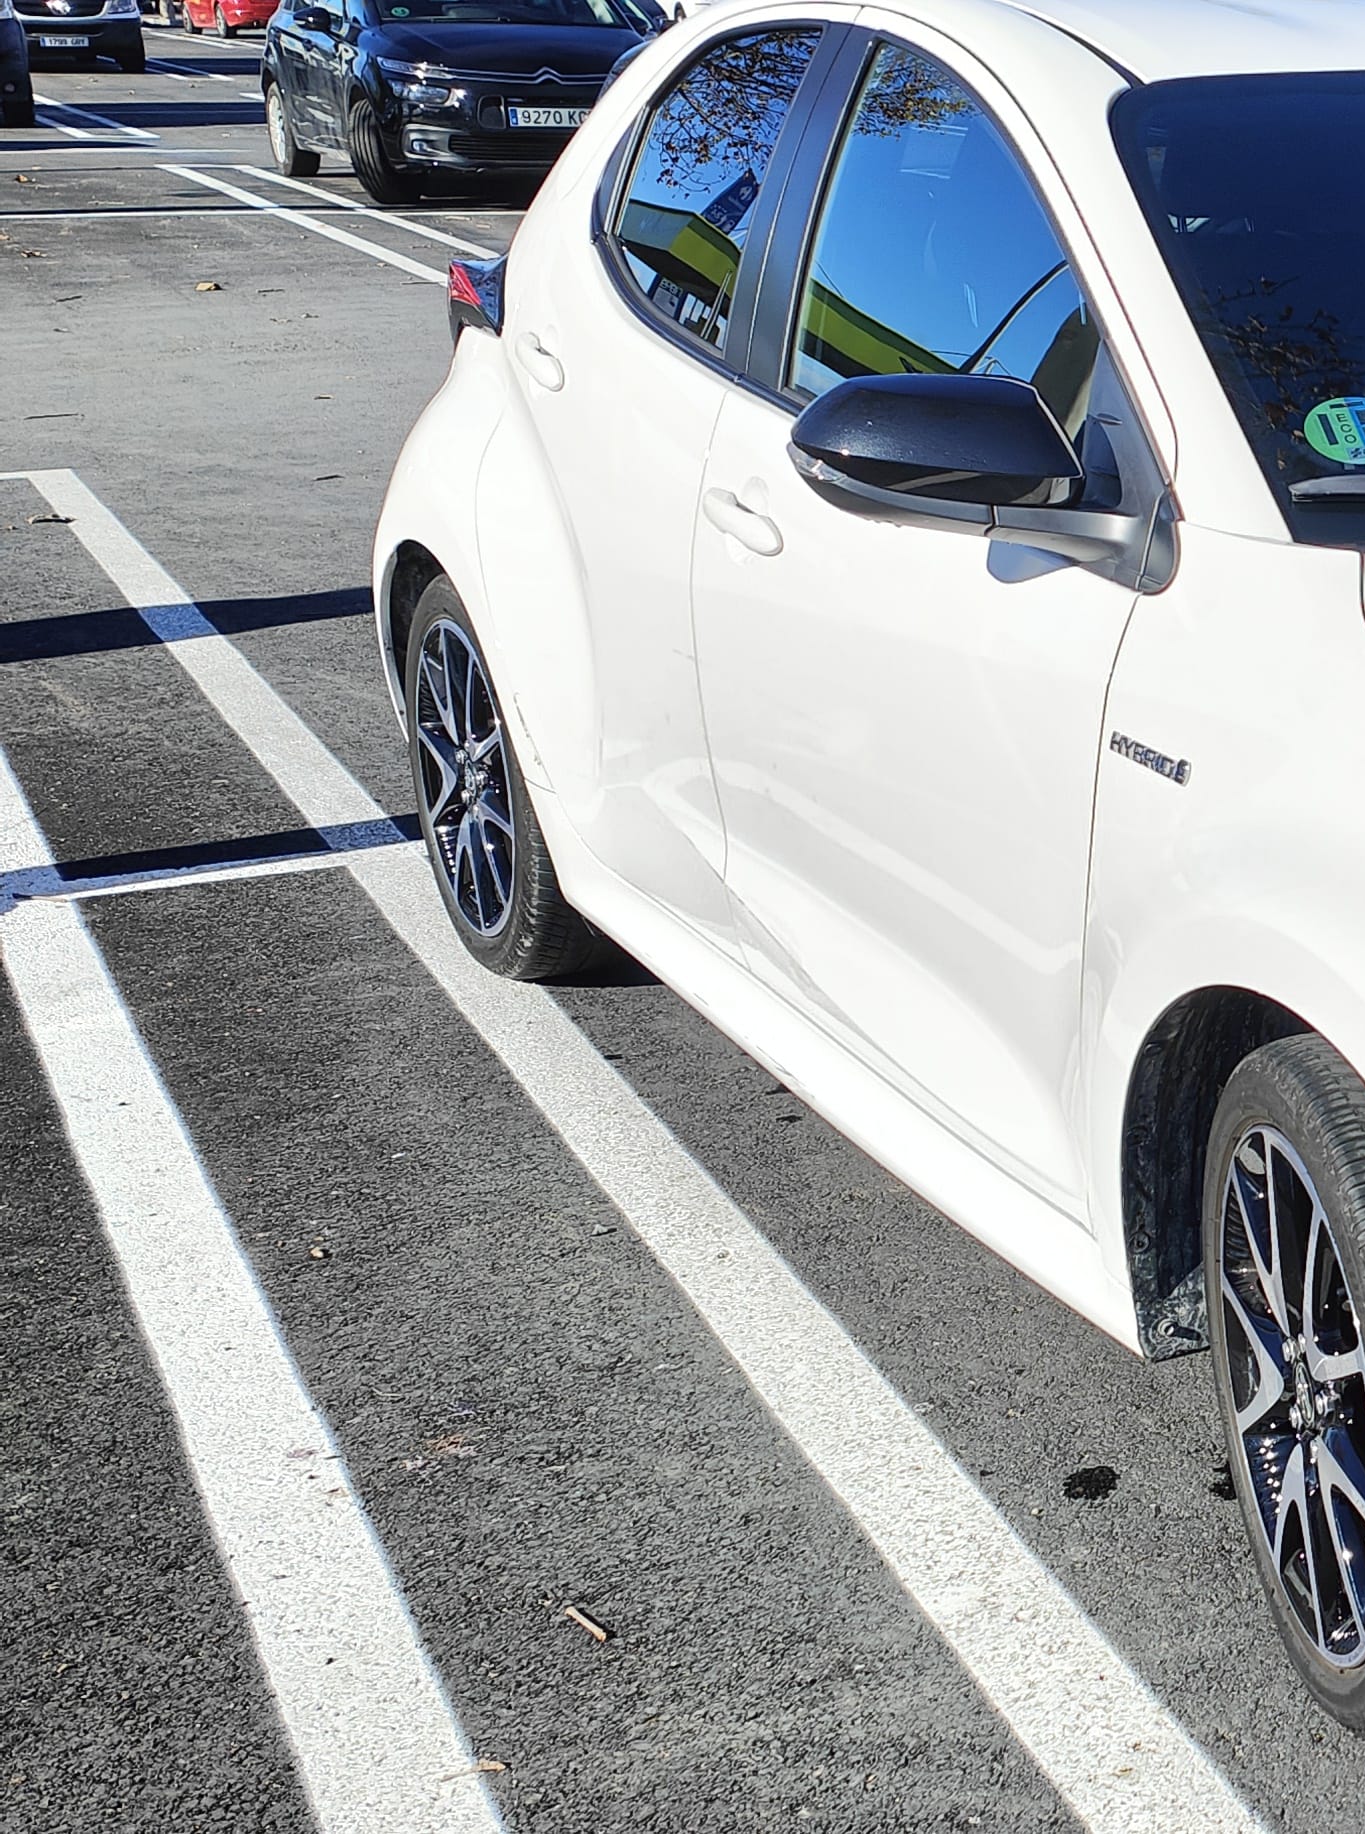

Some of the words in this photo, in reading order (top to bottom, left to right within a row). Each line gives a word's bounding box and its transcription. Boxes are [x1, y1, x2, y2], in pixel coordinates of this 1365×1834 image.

[522, 110, 562, 124] 9270
[568, 110, 591, 124] KC
[1336, 413, 1357, 444] ECO
[1109, 730, 1174, 778] HYBRID
